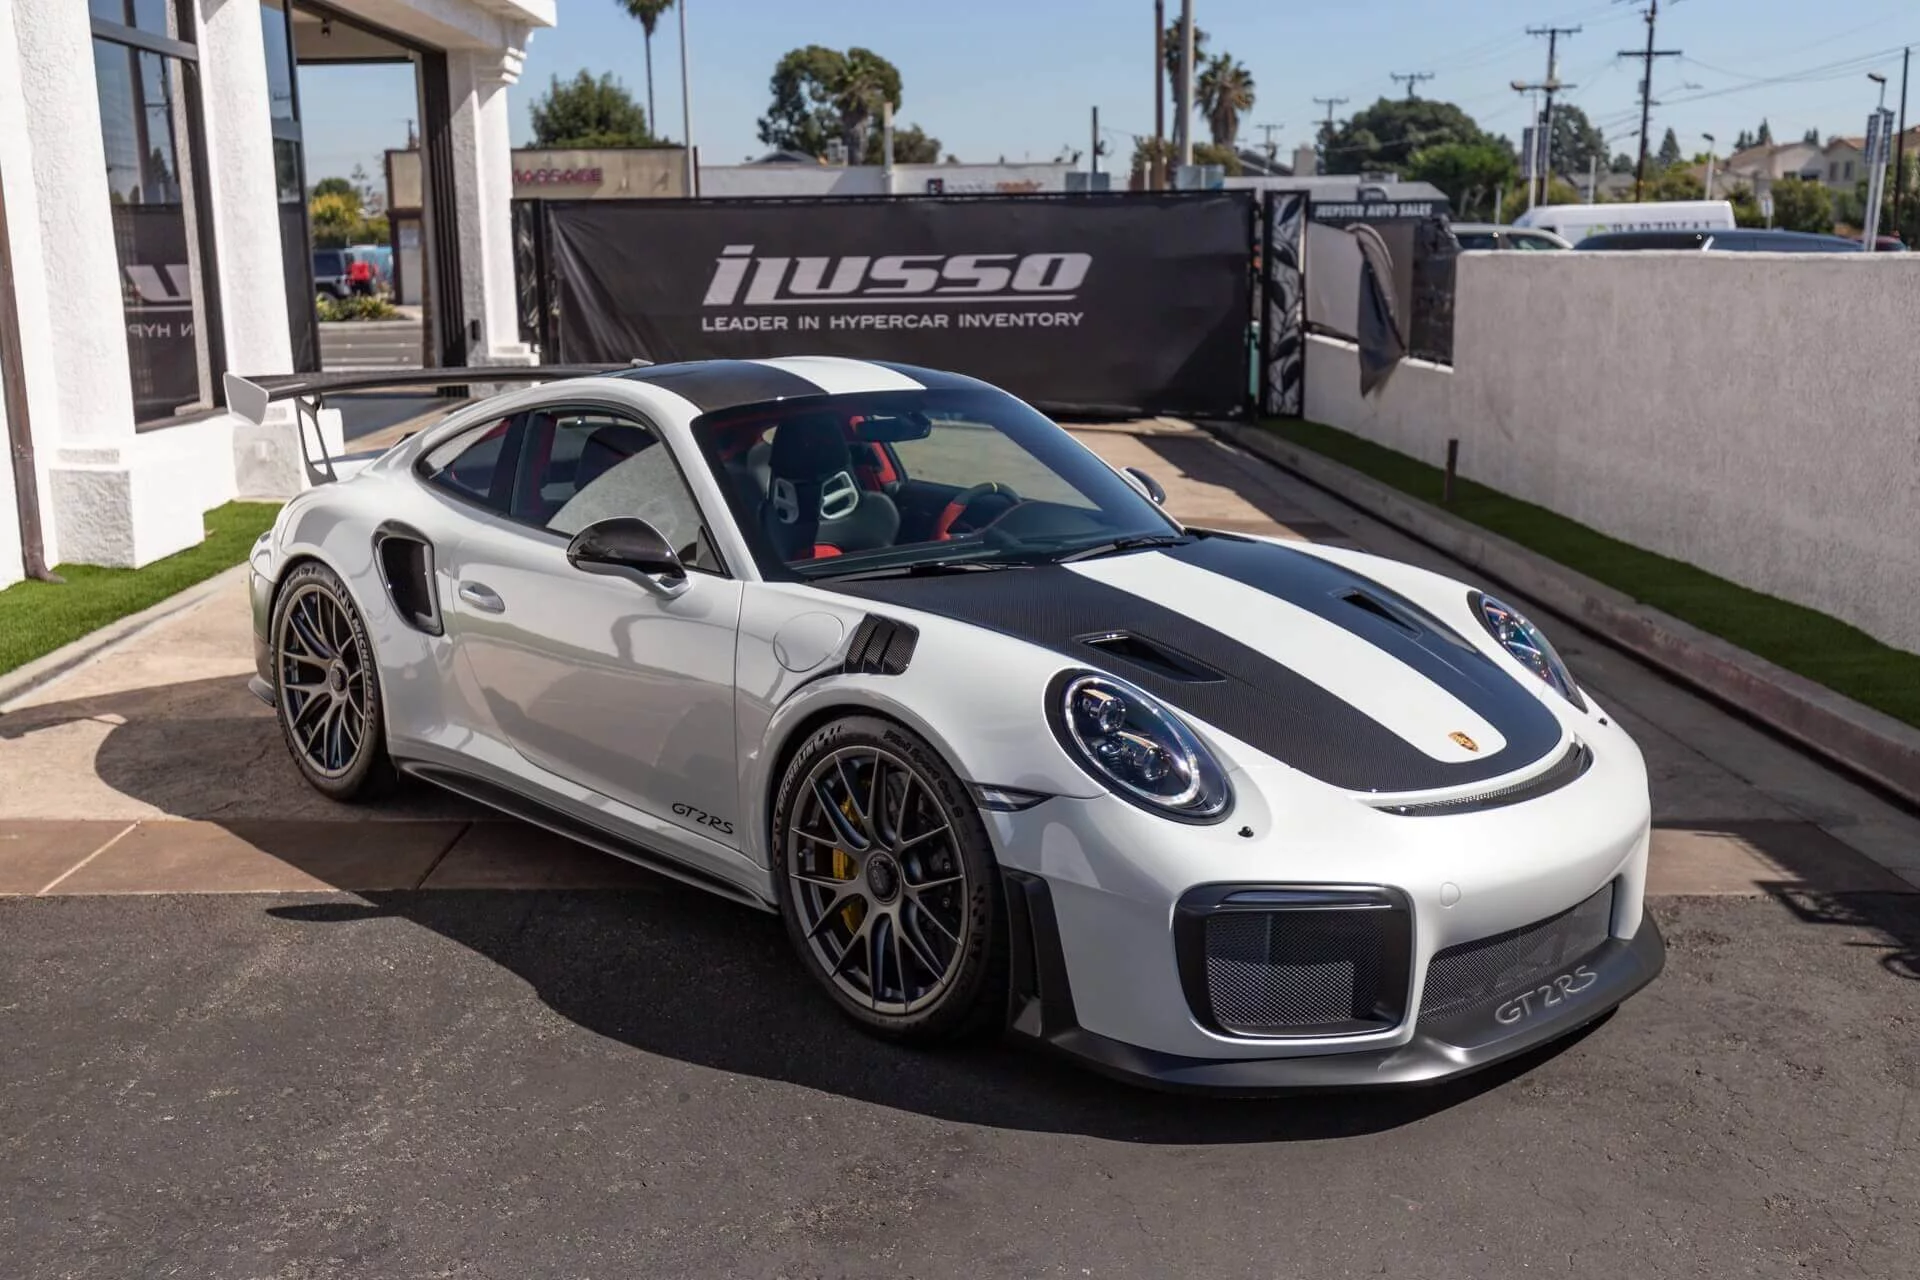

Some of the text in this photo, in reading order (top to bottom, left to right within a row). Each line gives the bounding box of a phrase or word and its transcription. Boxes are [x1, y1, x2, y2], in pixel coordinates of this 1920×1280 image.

[1366, 202, 1398, 217] AUTO
[1400, 202, 1433, 217] SALES
[702, 311, 1085, 331] LEADER IN HYPERCAR INVENTORY
[351, 617, 375, 700] MICHELIN
[776, 740, 818, 814] MICHELIN
